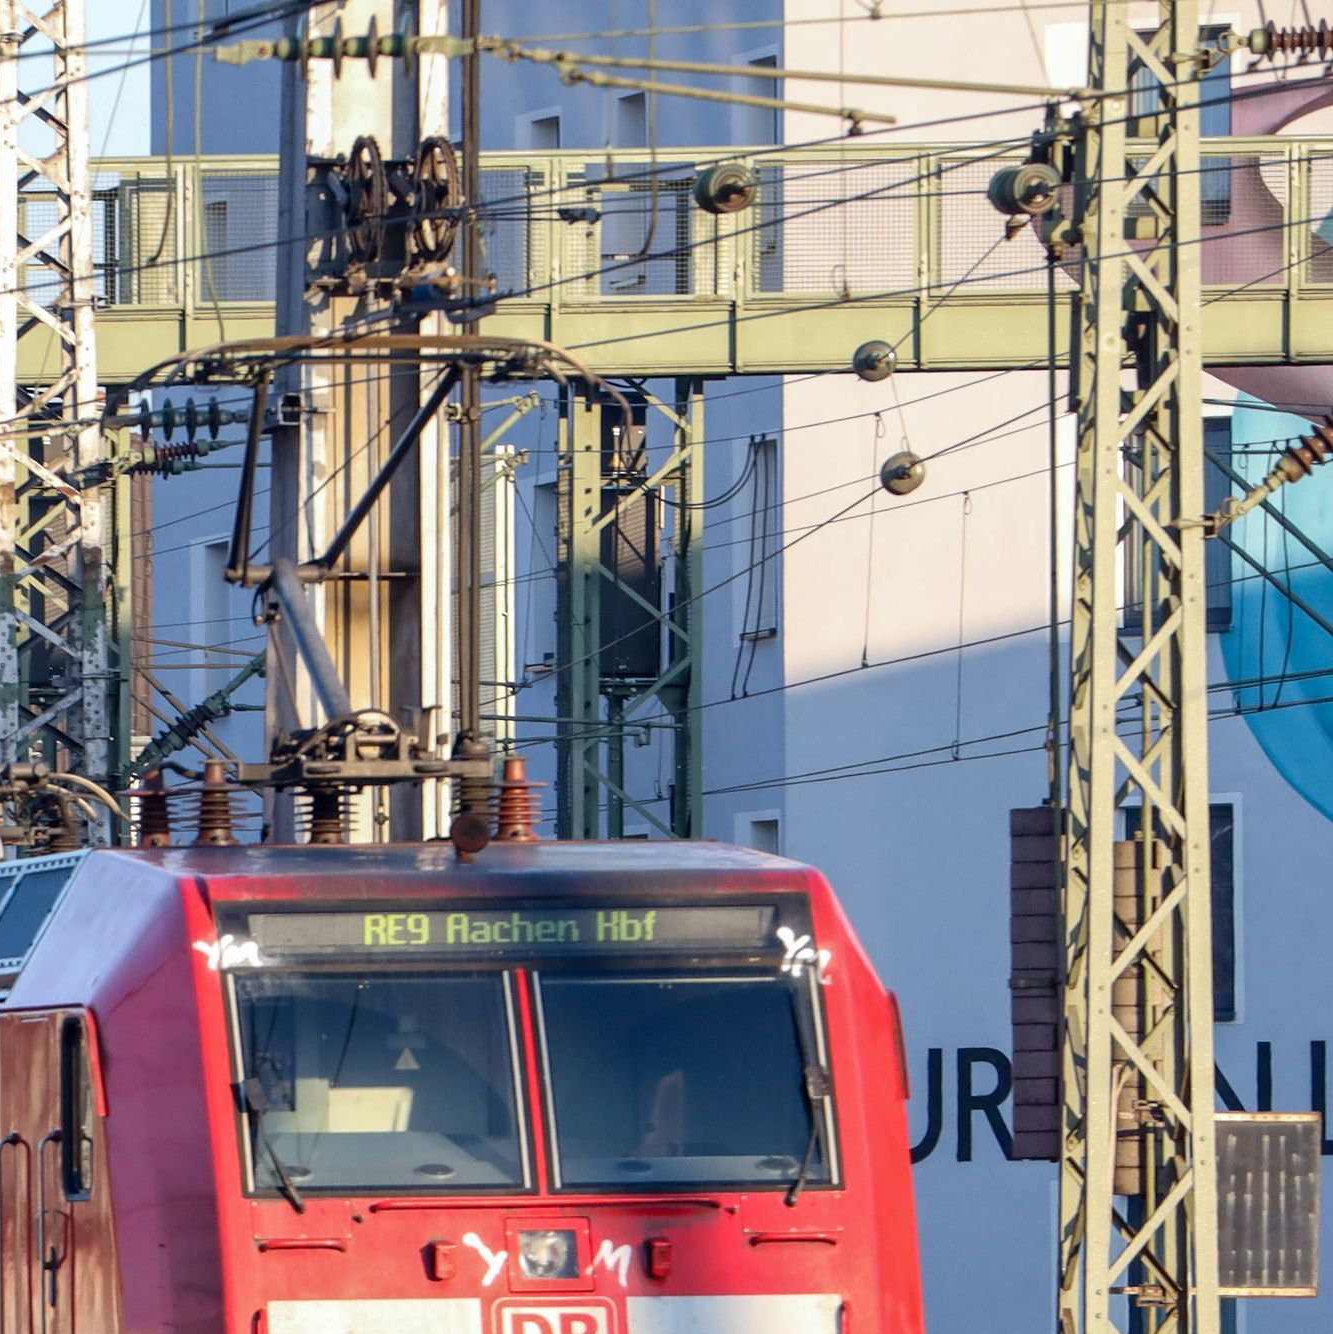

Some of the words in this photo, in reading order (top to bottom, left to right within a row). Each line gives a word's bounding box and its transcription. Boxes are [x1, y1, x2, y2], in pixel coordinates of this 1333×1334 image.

[364, 912, 430, 945] RE9
[446, 912, 580, 944] Aachen
[596, 910, 657, 942] Hbf
